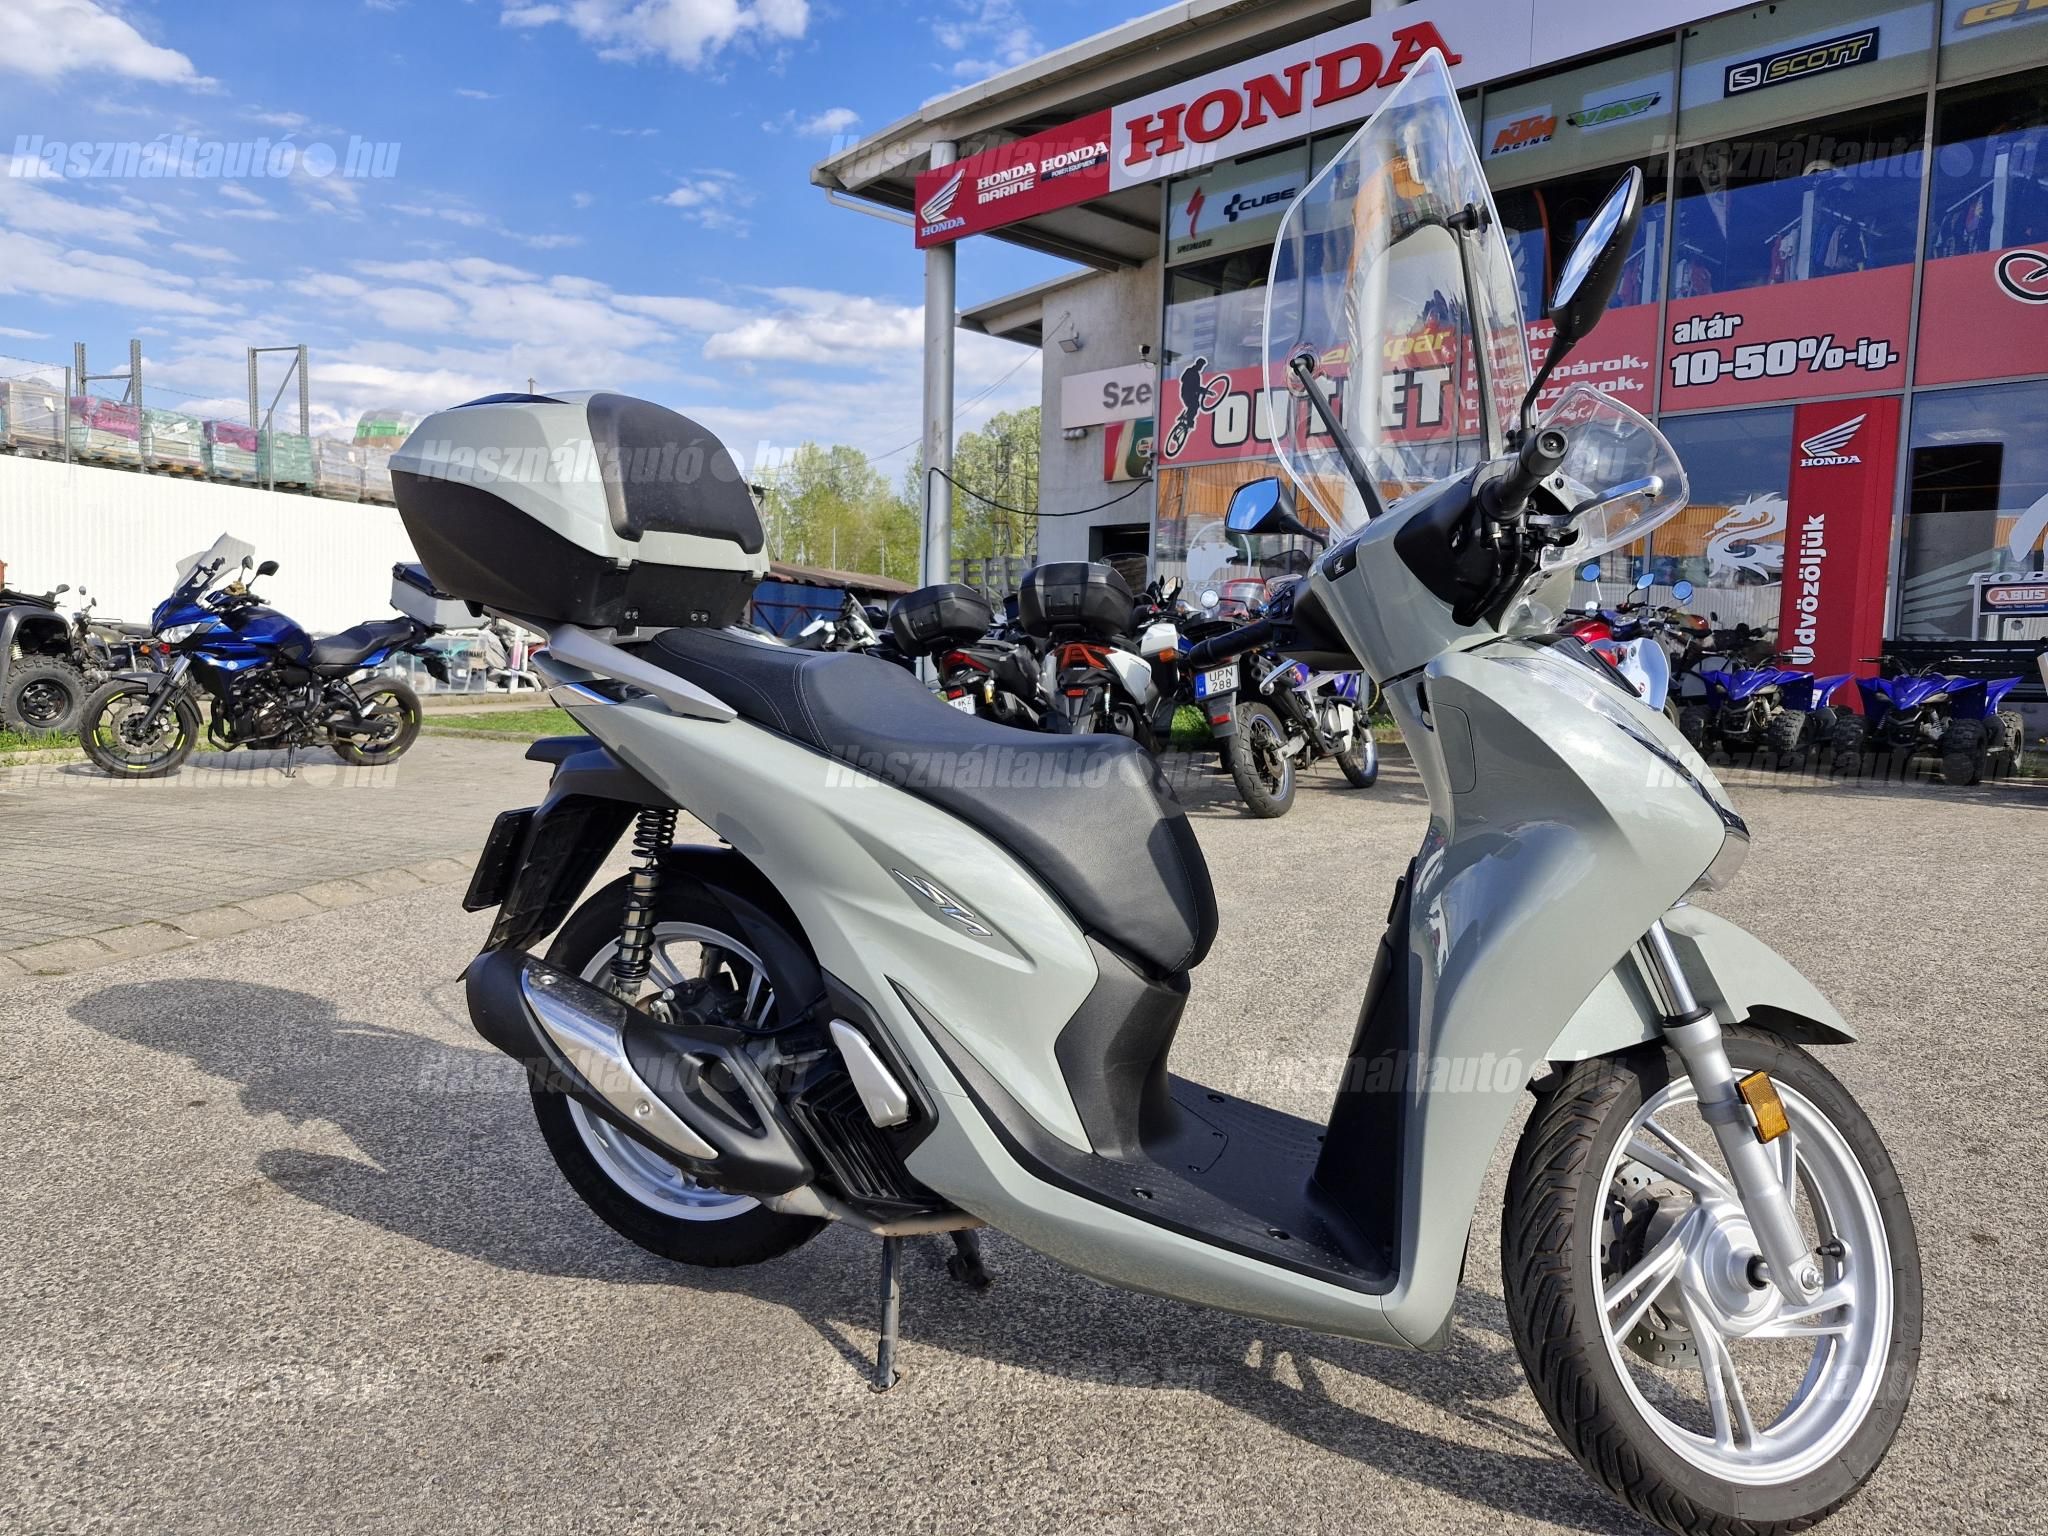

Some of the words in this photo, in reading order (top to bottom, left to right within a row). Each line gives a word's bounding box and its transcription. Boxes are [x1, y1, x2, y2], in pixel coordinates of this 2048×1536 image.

[1769, 38, 1868, 79] SCOTT
[1124, 21, 1462, 167] HONDA
[1494, 114, 1558, 148] KTM
[1490, 134, 1553, 155] RACING
[977, 162, 1037, 190] HONDA
[1040, 141, 1109, 174] HONDA
[977, 178, 1035, 205] MARINE
[1238, 187, 1296, 211] CUBE
[921, 216, 966, 237] HONDA
[1673, 312, 1743, 344] akár
[1671, 335, 1898, 387] 10-50%-ig.
[1800, 454, 1862, 467] HONDA
[1995, 589, 2046, 601] ABUS
[1209, 667, 1233, 682] UPN
[1212, 679, 1232, 692] 288
